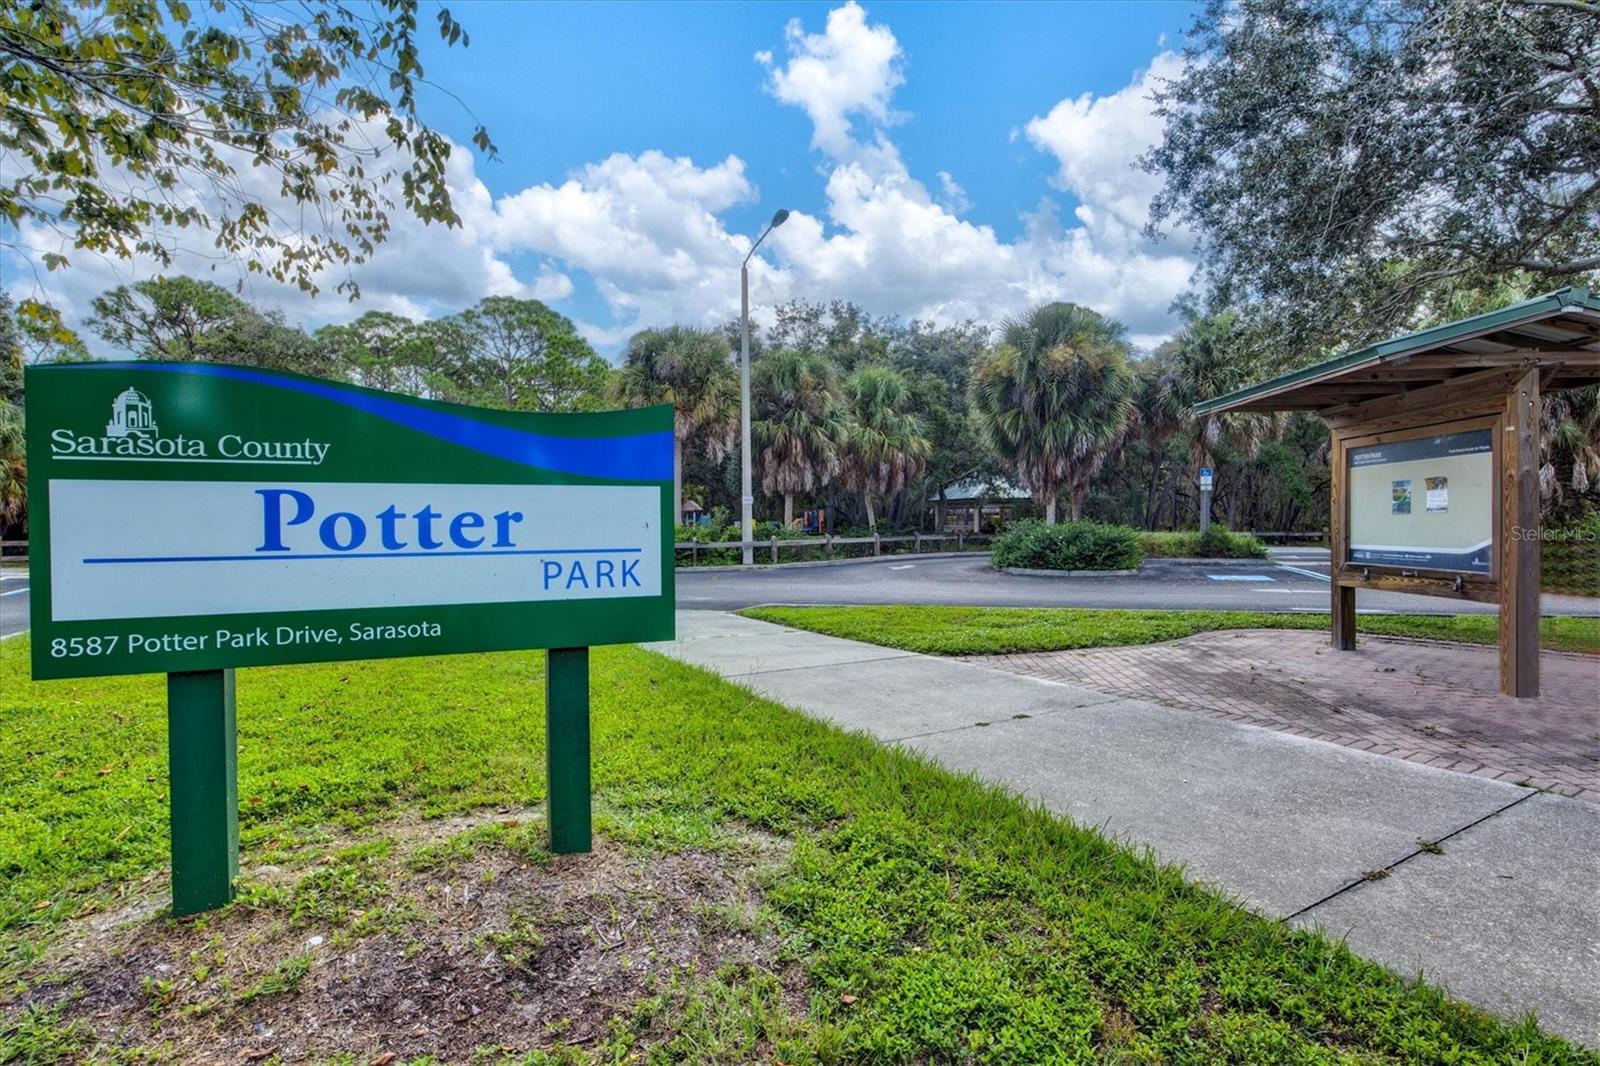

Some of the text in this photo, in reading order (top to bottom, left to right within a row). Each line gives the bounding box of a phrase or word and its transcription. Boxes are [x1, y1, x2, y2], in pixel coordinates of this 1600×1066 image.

[50, 429, 331, 465] Sarasota County
[255, 489, 524, 552] Potter
[542, 559, 642, 591] PARK
[50, 621, 442, 658] 8587 Potter Park Drive, Sarasota
